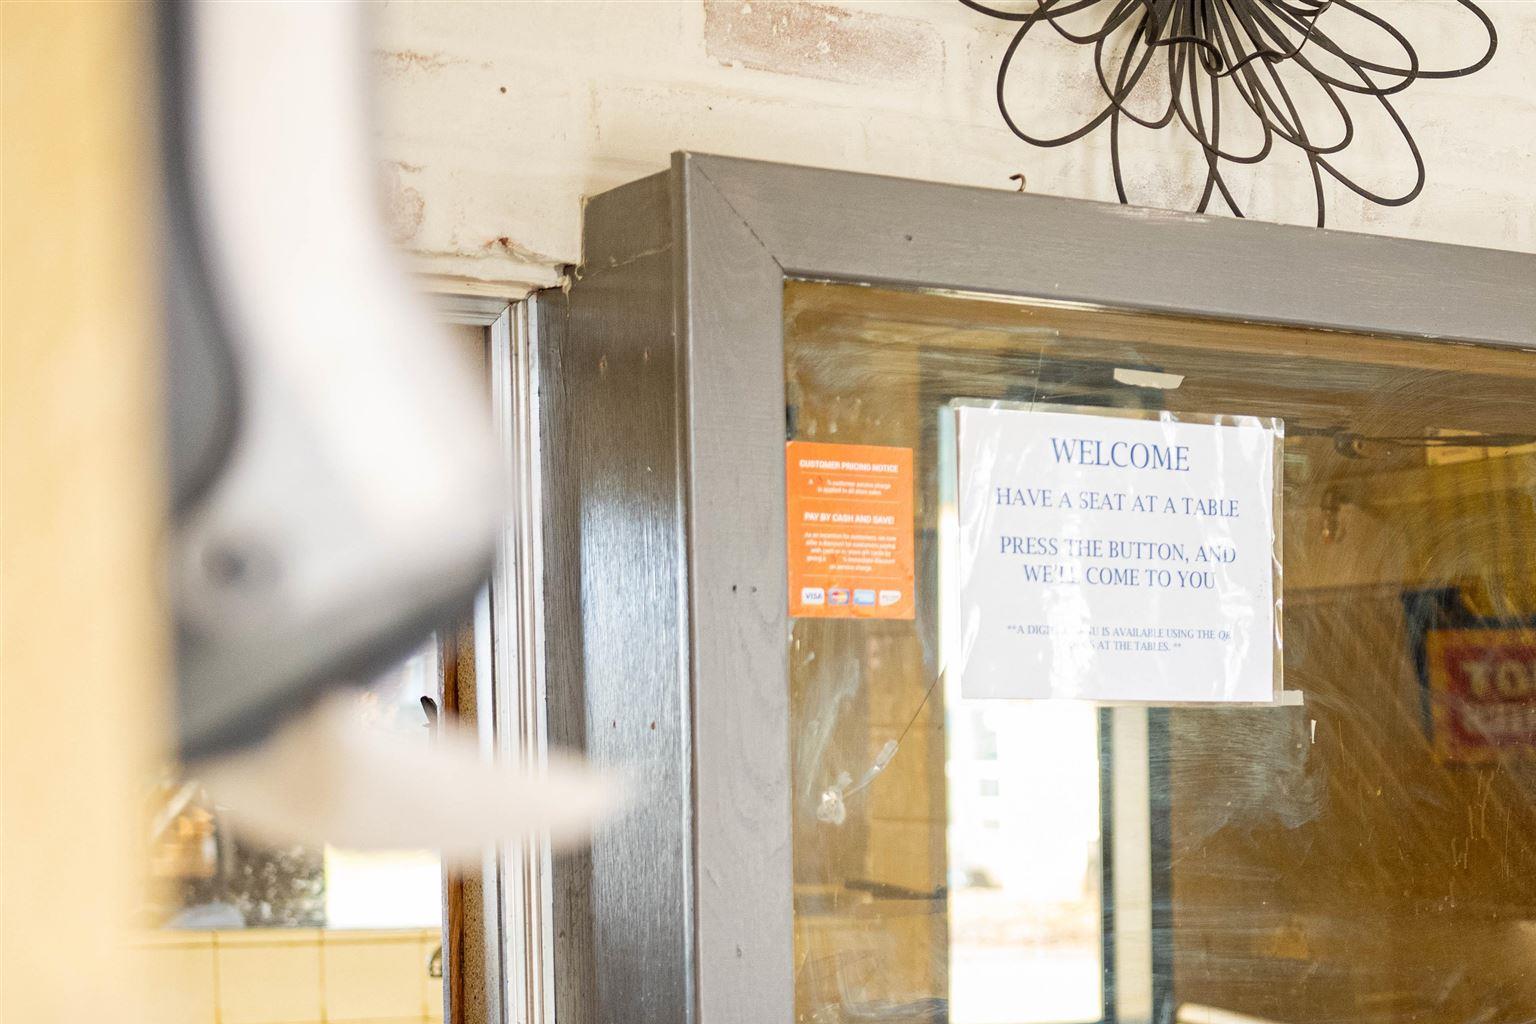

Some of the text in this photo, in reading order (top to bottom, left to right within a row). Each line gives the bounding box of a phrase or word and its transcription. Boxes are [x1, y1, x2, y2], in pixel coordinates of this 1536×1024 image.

[1051, 437, 1190, 472] WELCOME
[799, 459, 899, 473] CUSTOMER PRICING NOTICE
[996, 487, 1240, 517] HAVE A SEAT AT A TABLE
[803, 511, 819, 521] PAY
[820, 512, 831, 522] BY
[832, 513, 855, 523] CASH
[855, 514, 872, 524] AND
[1000, 536, 1236, 564] PRESS THE BUTTON, AND
[1023, 564, 1216, 589] WE'LL COME TO YOU
[1112, 627, 1164, 638] AVAILABLE
[1166, 628, 1194, 639] USING
[1197, 629, 1216, 639] THE
[1097, 641, 1110, 650] AT
[1113, 641, 1132, 650] THE
